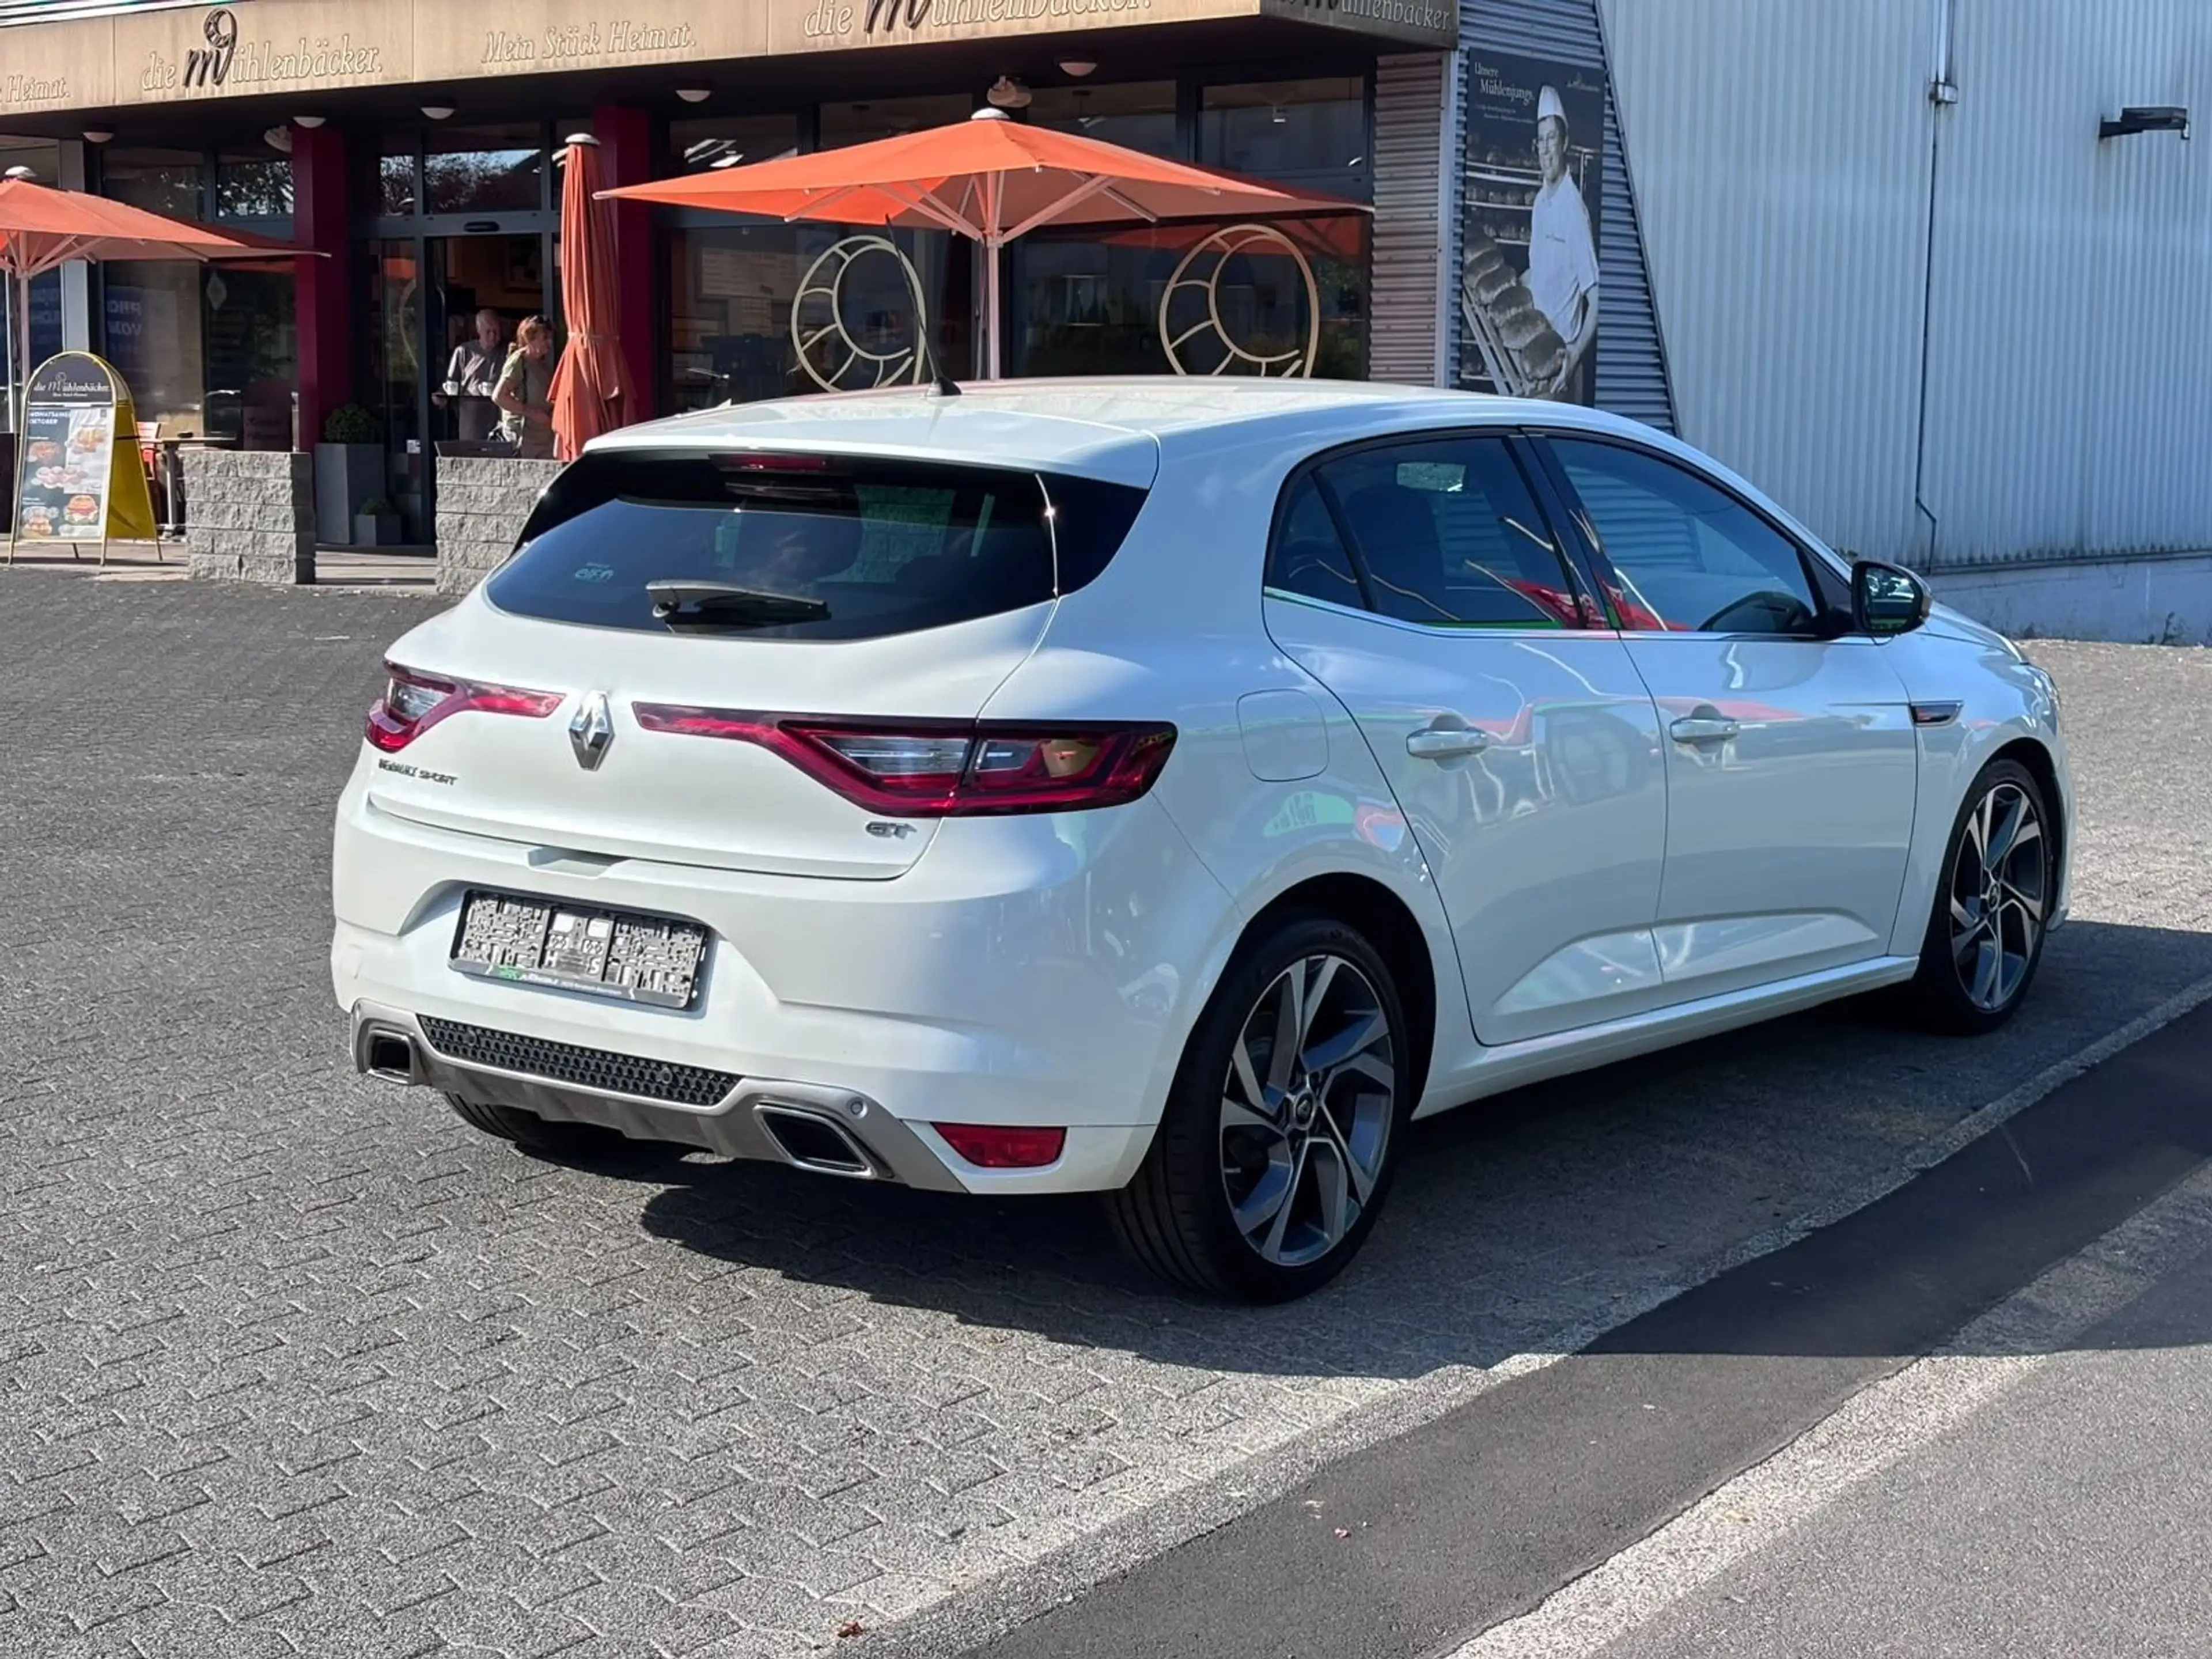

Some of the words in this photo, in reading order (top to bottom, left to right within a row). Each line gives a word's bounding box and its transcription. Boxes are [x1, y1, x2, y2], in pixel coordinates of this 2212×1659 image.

[805, 0, 853, 37] die
[142, 51, 176, 90] die
[182, 9, 382, 88] Mühlenbäcker.
[482, 32, 535, 63] Mein
[542, 22, 601, 58] Stück
[607, 21, 696, 52] Heimat.
[6, 74, 70, 103] Heimat.
[865, 821, 918, 840] GT
